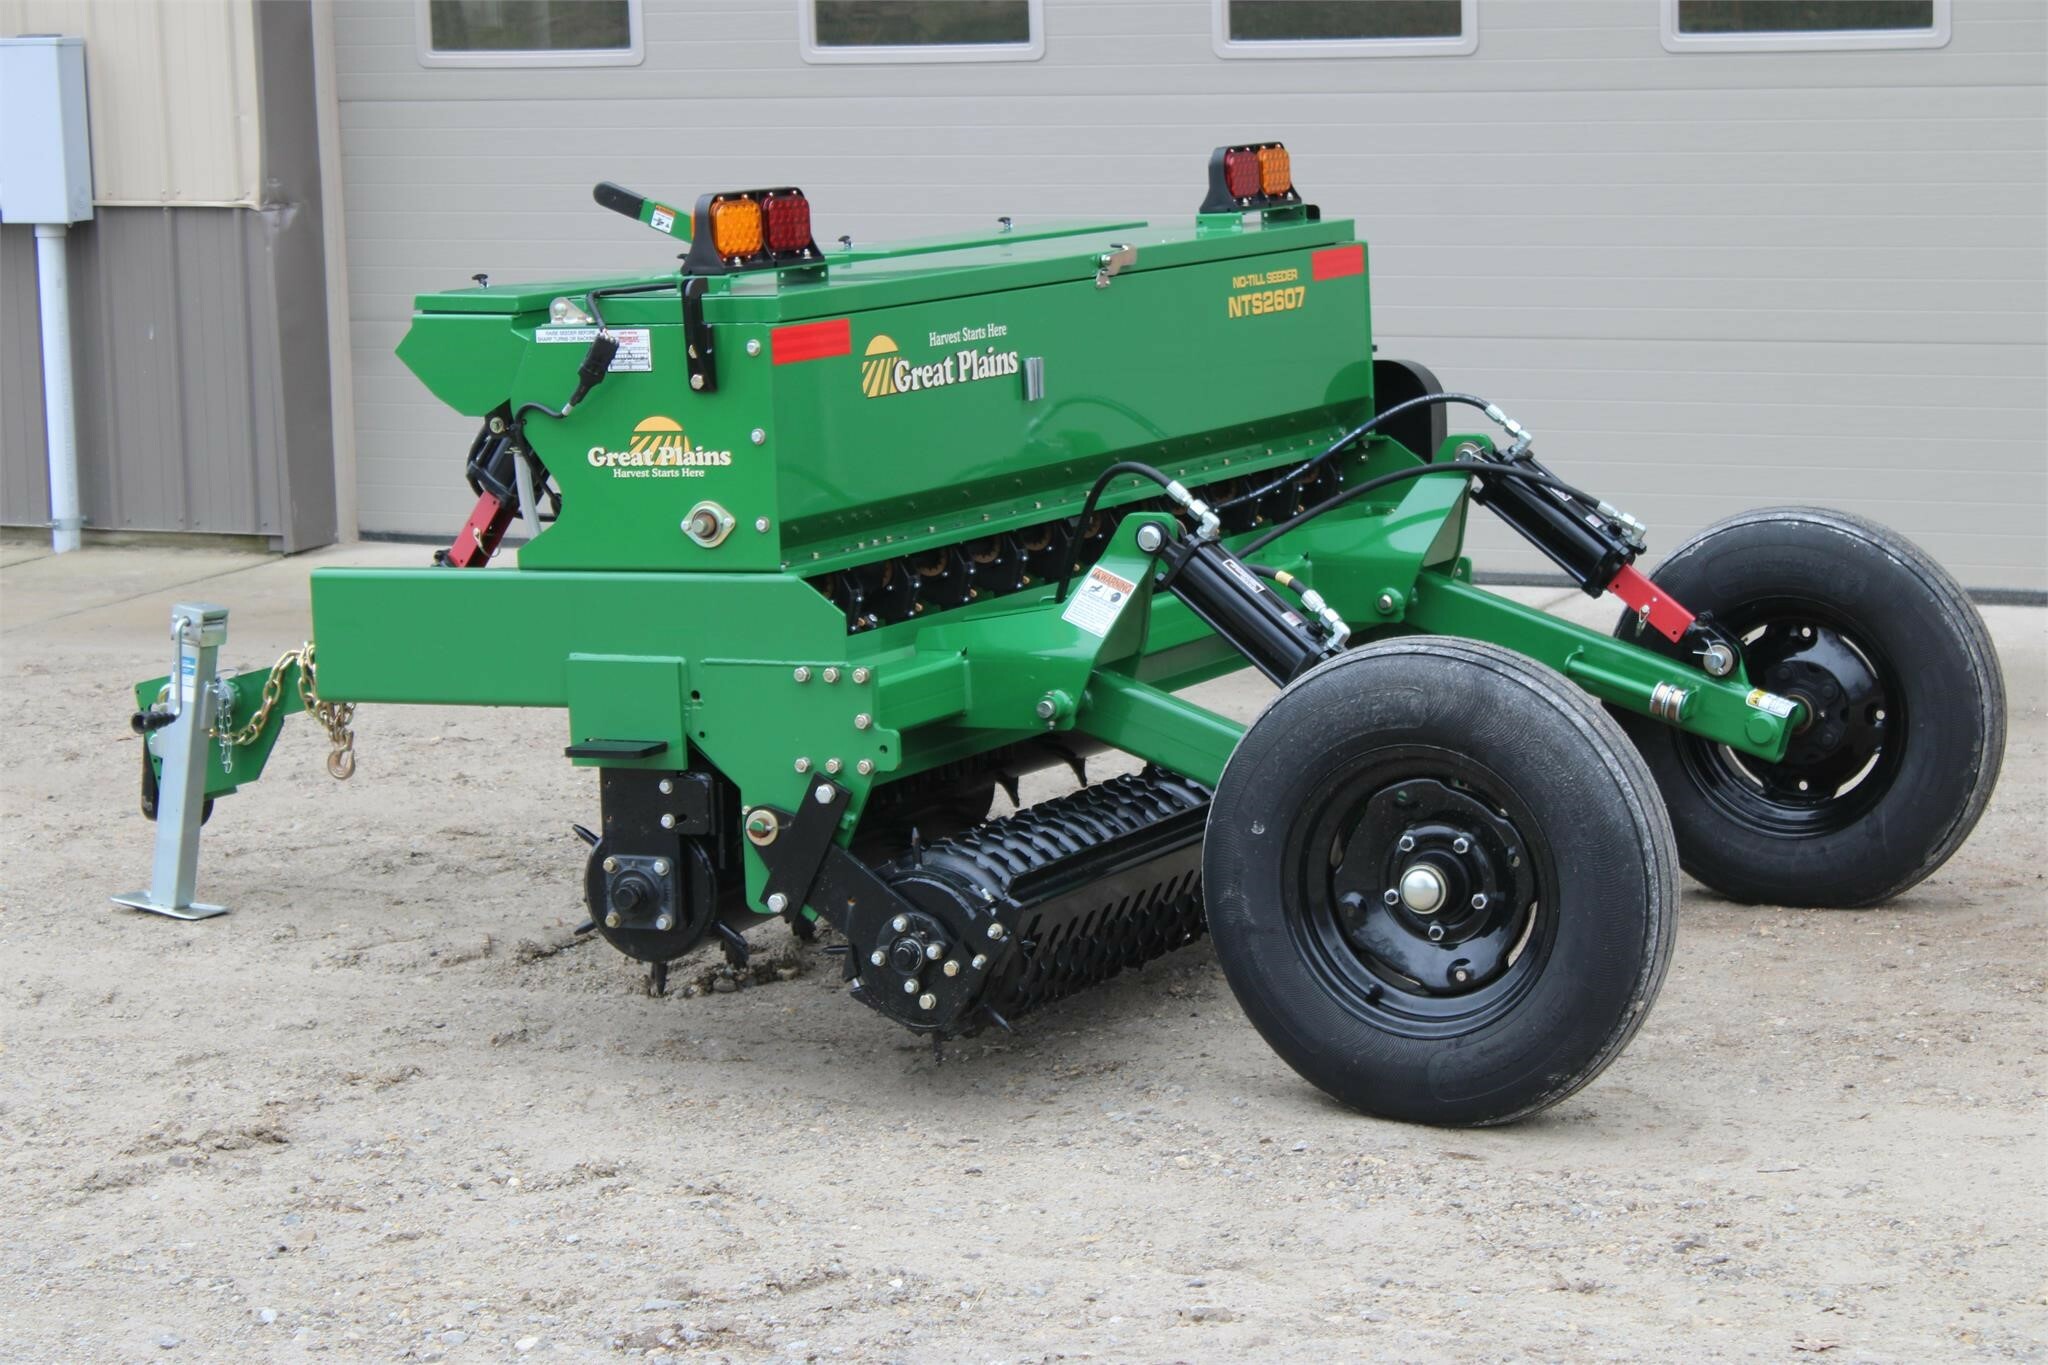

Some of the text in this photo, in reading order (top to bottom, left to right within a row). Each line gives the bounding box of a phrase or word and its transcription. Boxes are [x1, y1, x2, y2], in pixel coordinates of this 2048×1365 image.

[1232, 268, 1298, 288] NO-TILL SEEDER
[1228, 286, 1305, 318] NTS2607
[929, 323, 1007, 347] Harvest Starts Here
[894, 346, 1019, 393] Great Plains
[587, 445, 732, 467] Great Plains
[613, 467, 705, 478] Harvest Starts Here
